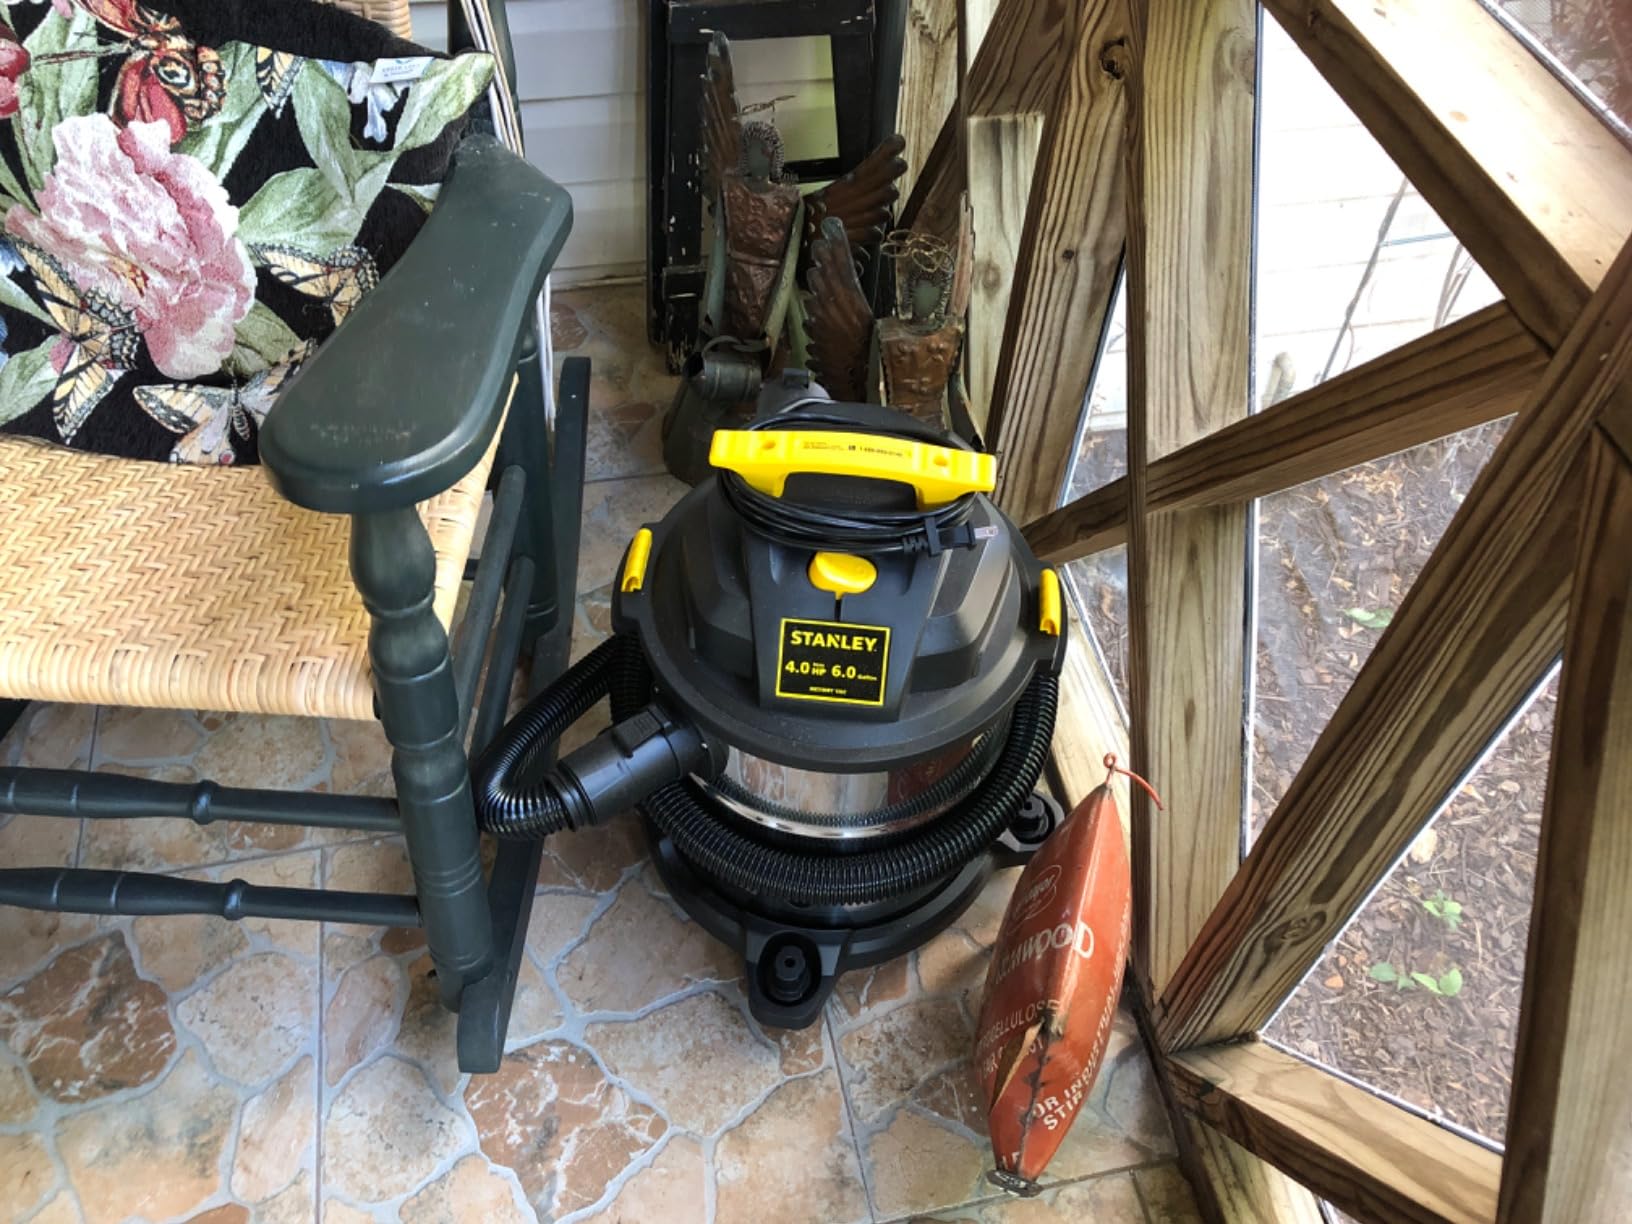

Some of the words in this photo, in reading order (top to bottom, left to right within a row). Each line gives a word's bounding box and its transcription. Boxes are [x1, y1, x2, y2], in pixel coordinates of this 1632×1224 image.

[789, 629, 878, 652] STANLEY
[785, 660, 810, 674] 4.0
[831, 664, 857, 679] 6.0
